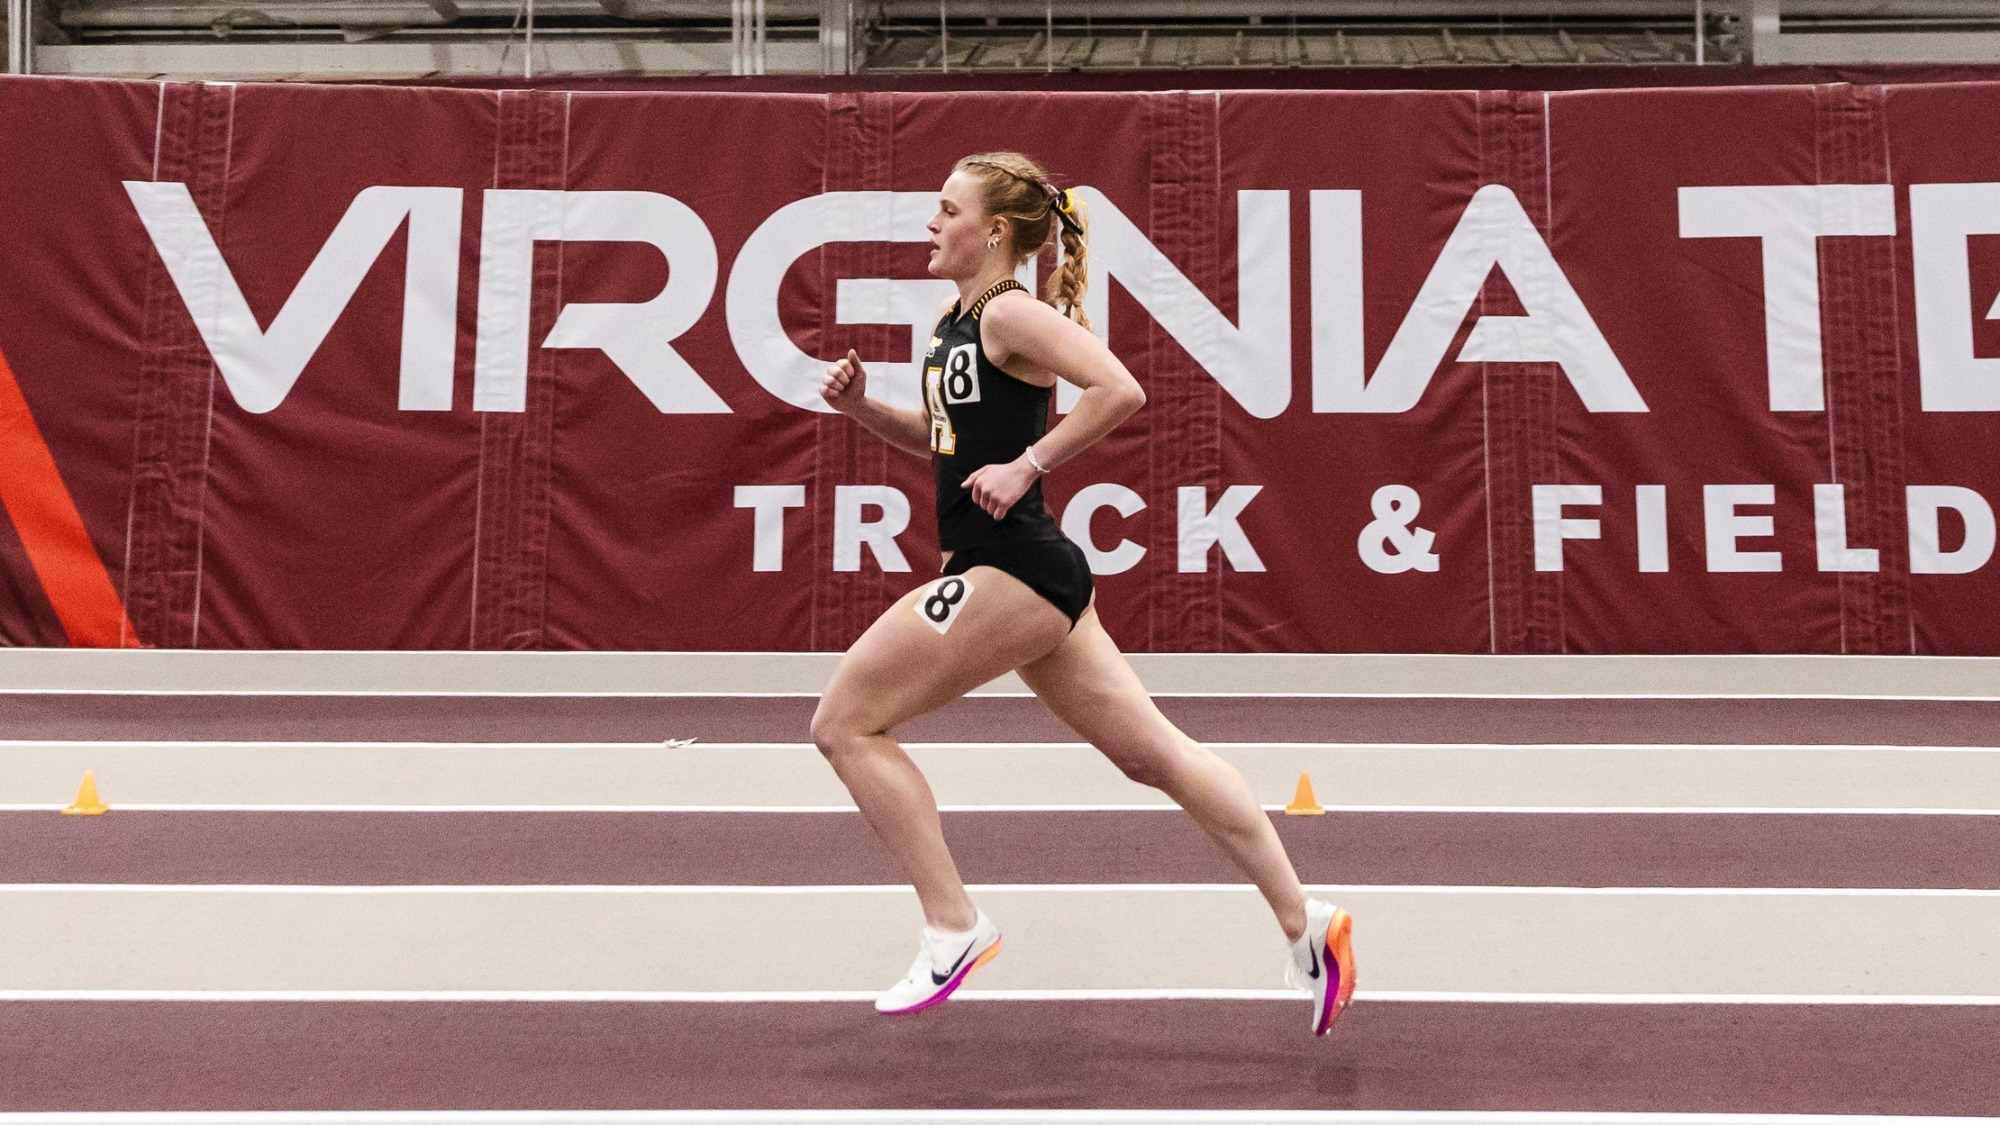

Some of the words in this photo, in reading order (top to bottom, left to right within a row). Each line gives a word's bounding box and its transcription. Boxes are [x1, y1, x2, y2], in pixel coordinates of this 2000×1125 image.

[122, 181, 1649, 419] VIRGNIA
[925, 365, 956, 456] A
[948, 349, 974, 400] 8
[733, 483, 1267, 576] TRCK
[1358, 484, 1440, 575] &
[1532, 483, 1997, 575] FIELD
[924, 577, 965, 623] 8
